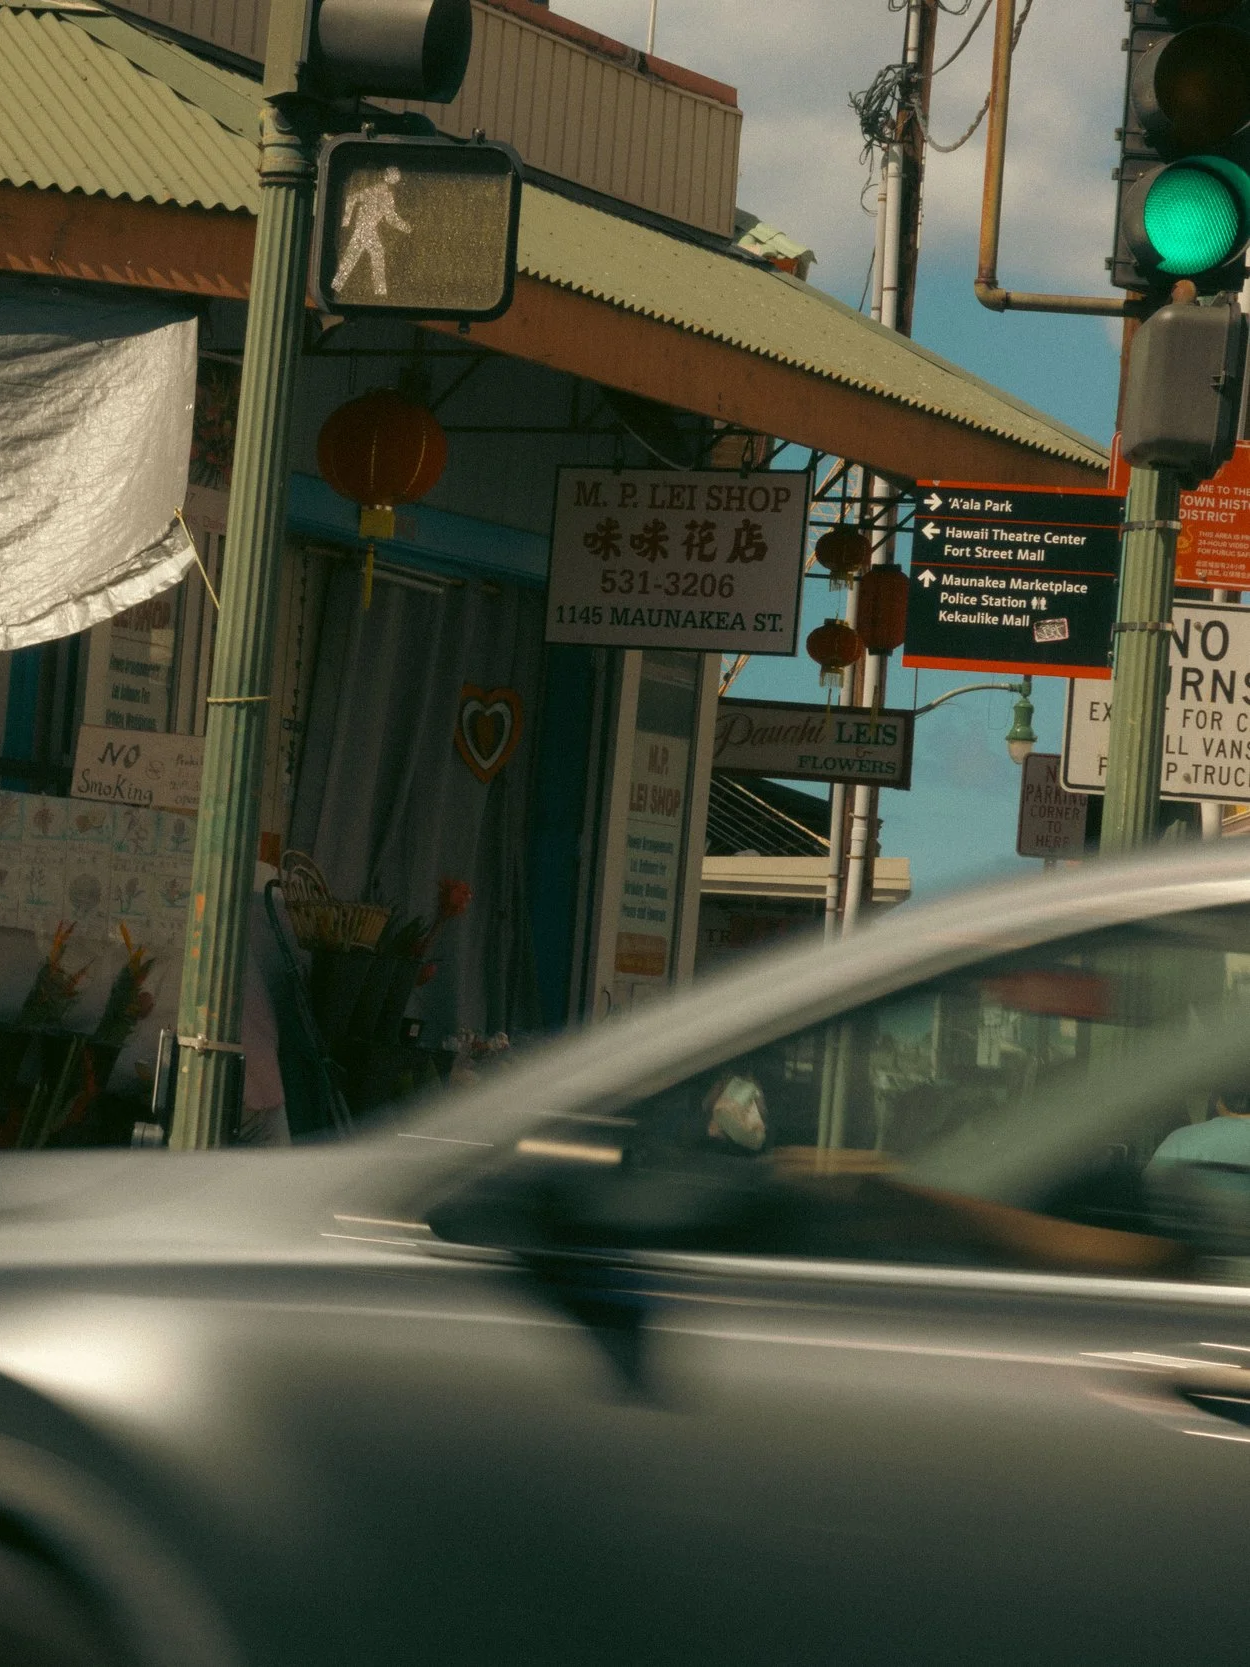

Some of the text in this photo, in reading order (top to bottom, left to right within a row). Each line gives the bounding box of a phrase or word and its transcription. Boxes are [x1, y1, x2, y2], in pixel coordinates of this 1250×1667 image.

[573, 480, 792, 513] M. P. LEI SHOP
[1217, 486, 1230, 494] TO
[984, 499, 1012, 513] Park
[1219, 499, 1250, 511] HIST
[1178, 508, 1236, 523] DISTRICT
[945, 526, 1087, 546] Hawaii Theatre Center
[944, 544, 1045, 562] Fort Street Mall
[600, 569, 735, 599] 531-3206
[941, 574, 1088, 595] Maunakea Marketplace
[940, 592, 1027, 608] Police Station
[556, 605, 784, 633] 1145 MAUNAKEA ST.
[938, 610, 1030, 627] Kekaulike Mall
[1170, 618, 1230, 662] NO
[1182, 709, 1223, 731] FOR
[835, 720, 898, 746] LEIS
[98, 742, 141, 769] NO
[797, 755, 897, 775] FLOWERS
[1046, 765, 1058, 783] N
[1192, 763, 1250, 788] TRUC
[629, 781, 681, 818] LEI SHOP
[1025, 783, 1087, 807] PARKING
[1030, 804, 1080, 821] CORNER
[1048, 820, 1062, 834] TO
